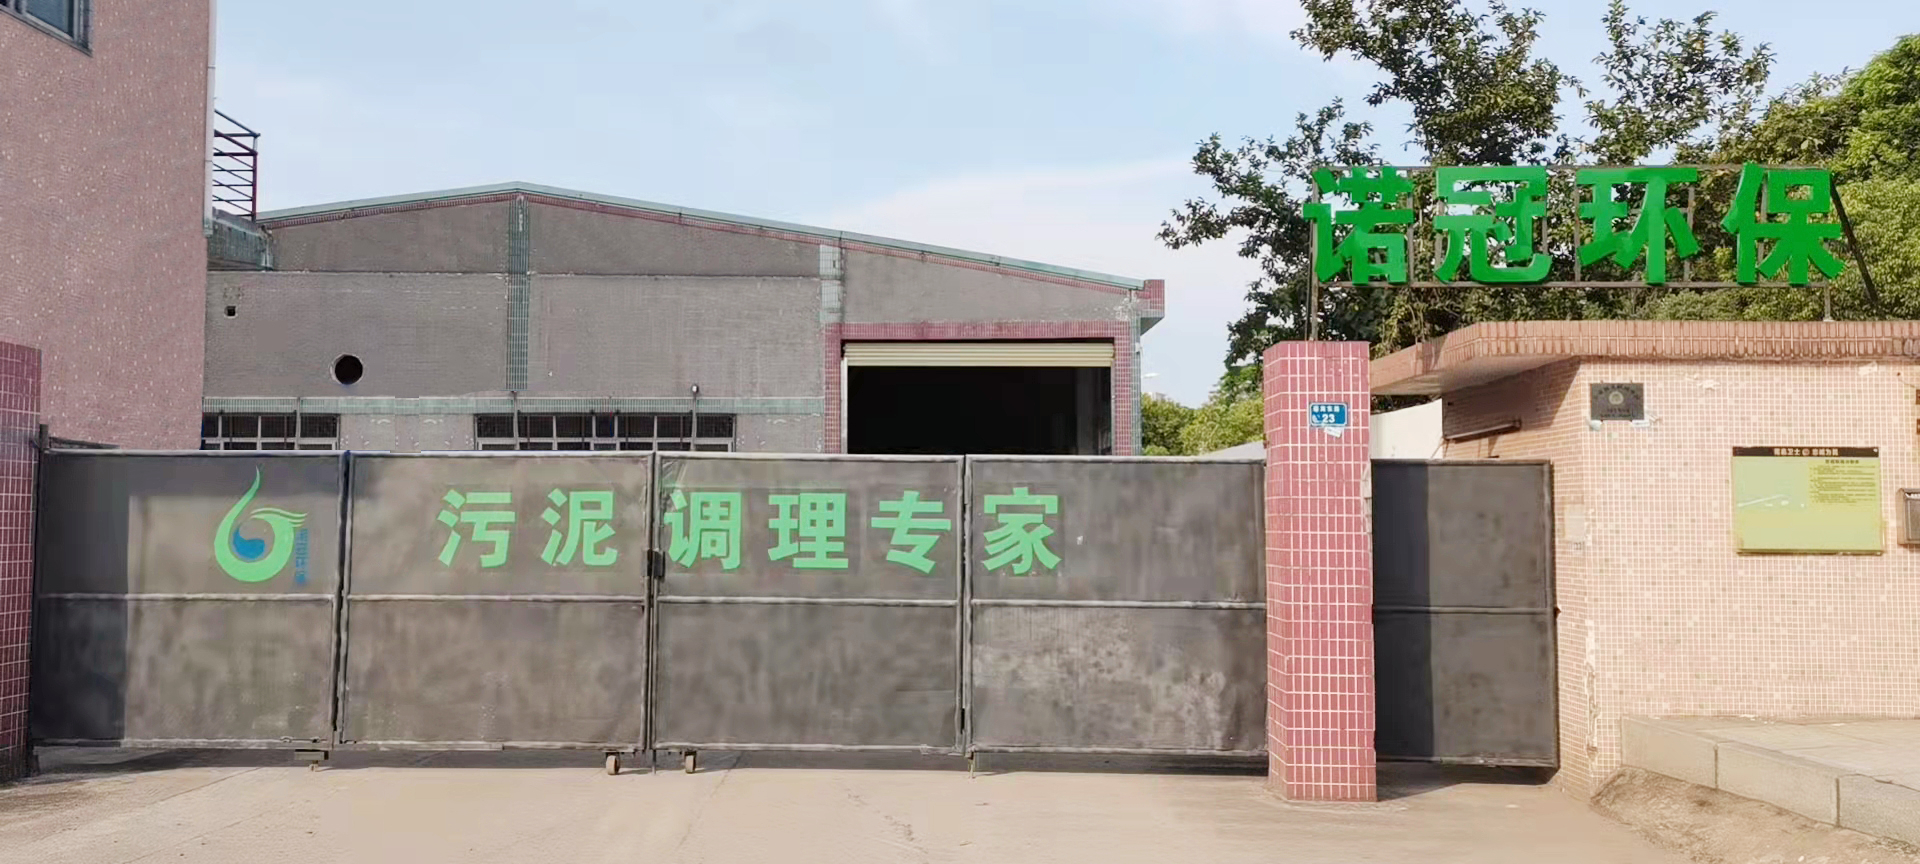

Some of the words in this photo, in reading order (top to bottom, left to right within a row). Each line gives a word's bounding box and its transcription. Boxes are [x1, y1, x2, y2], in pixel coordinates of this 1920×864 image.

[1303, 162, 1845, 286] 诺冠环保
[1322, 413, 1336, 423] 23
[438, 488, 1062, 575] 污泥调理专家
